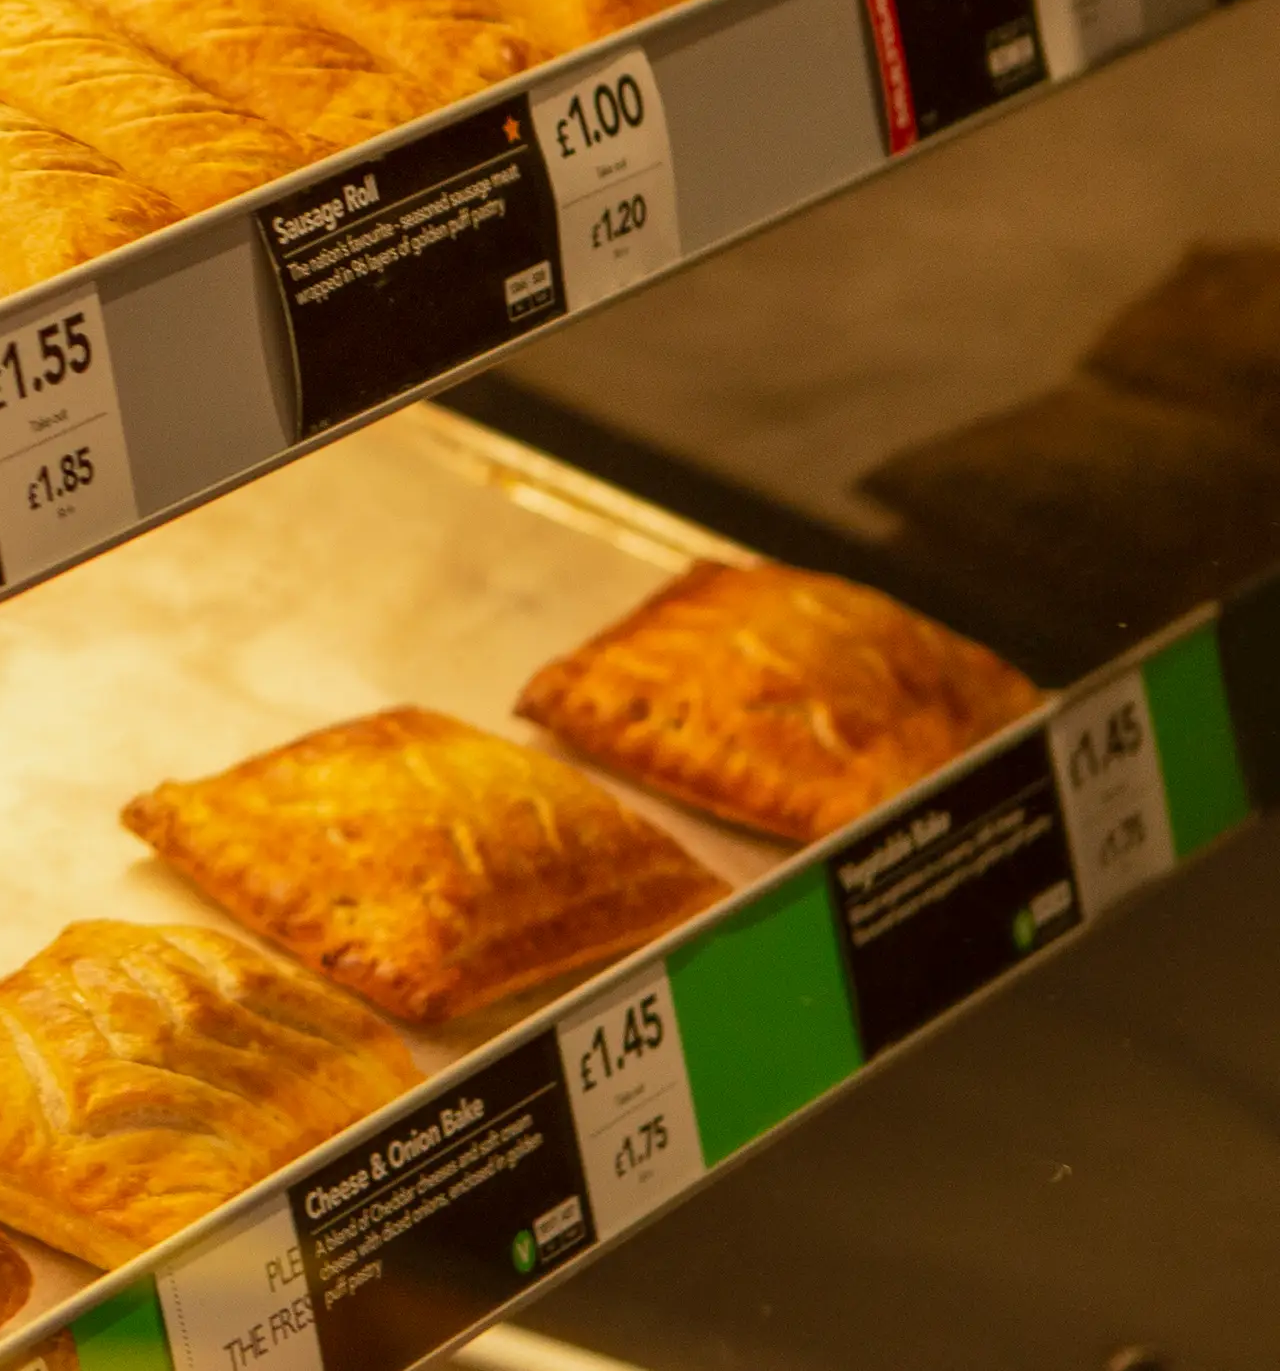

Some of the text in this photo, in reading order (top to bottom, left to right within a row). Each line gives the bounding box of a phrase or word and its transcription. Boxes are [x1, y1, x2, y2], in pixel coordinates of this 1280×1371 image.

[556, 73, 644, 158] £1.00
[273, 173, 380, 245] Sausage Roll
[591, 193, 647, 248] £1.20
[28, 446, 94, 511] £1.85
[579, 992, 666, 1094] £1.45
[305, 1097, 484, 1219] Cheese & Onion Bake
[614, 1114, 668, 1178] £1.75
[265, 1246, 305, 1293] PLE
[222, 1293, 316, 1371] THE FRES
